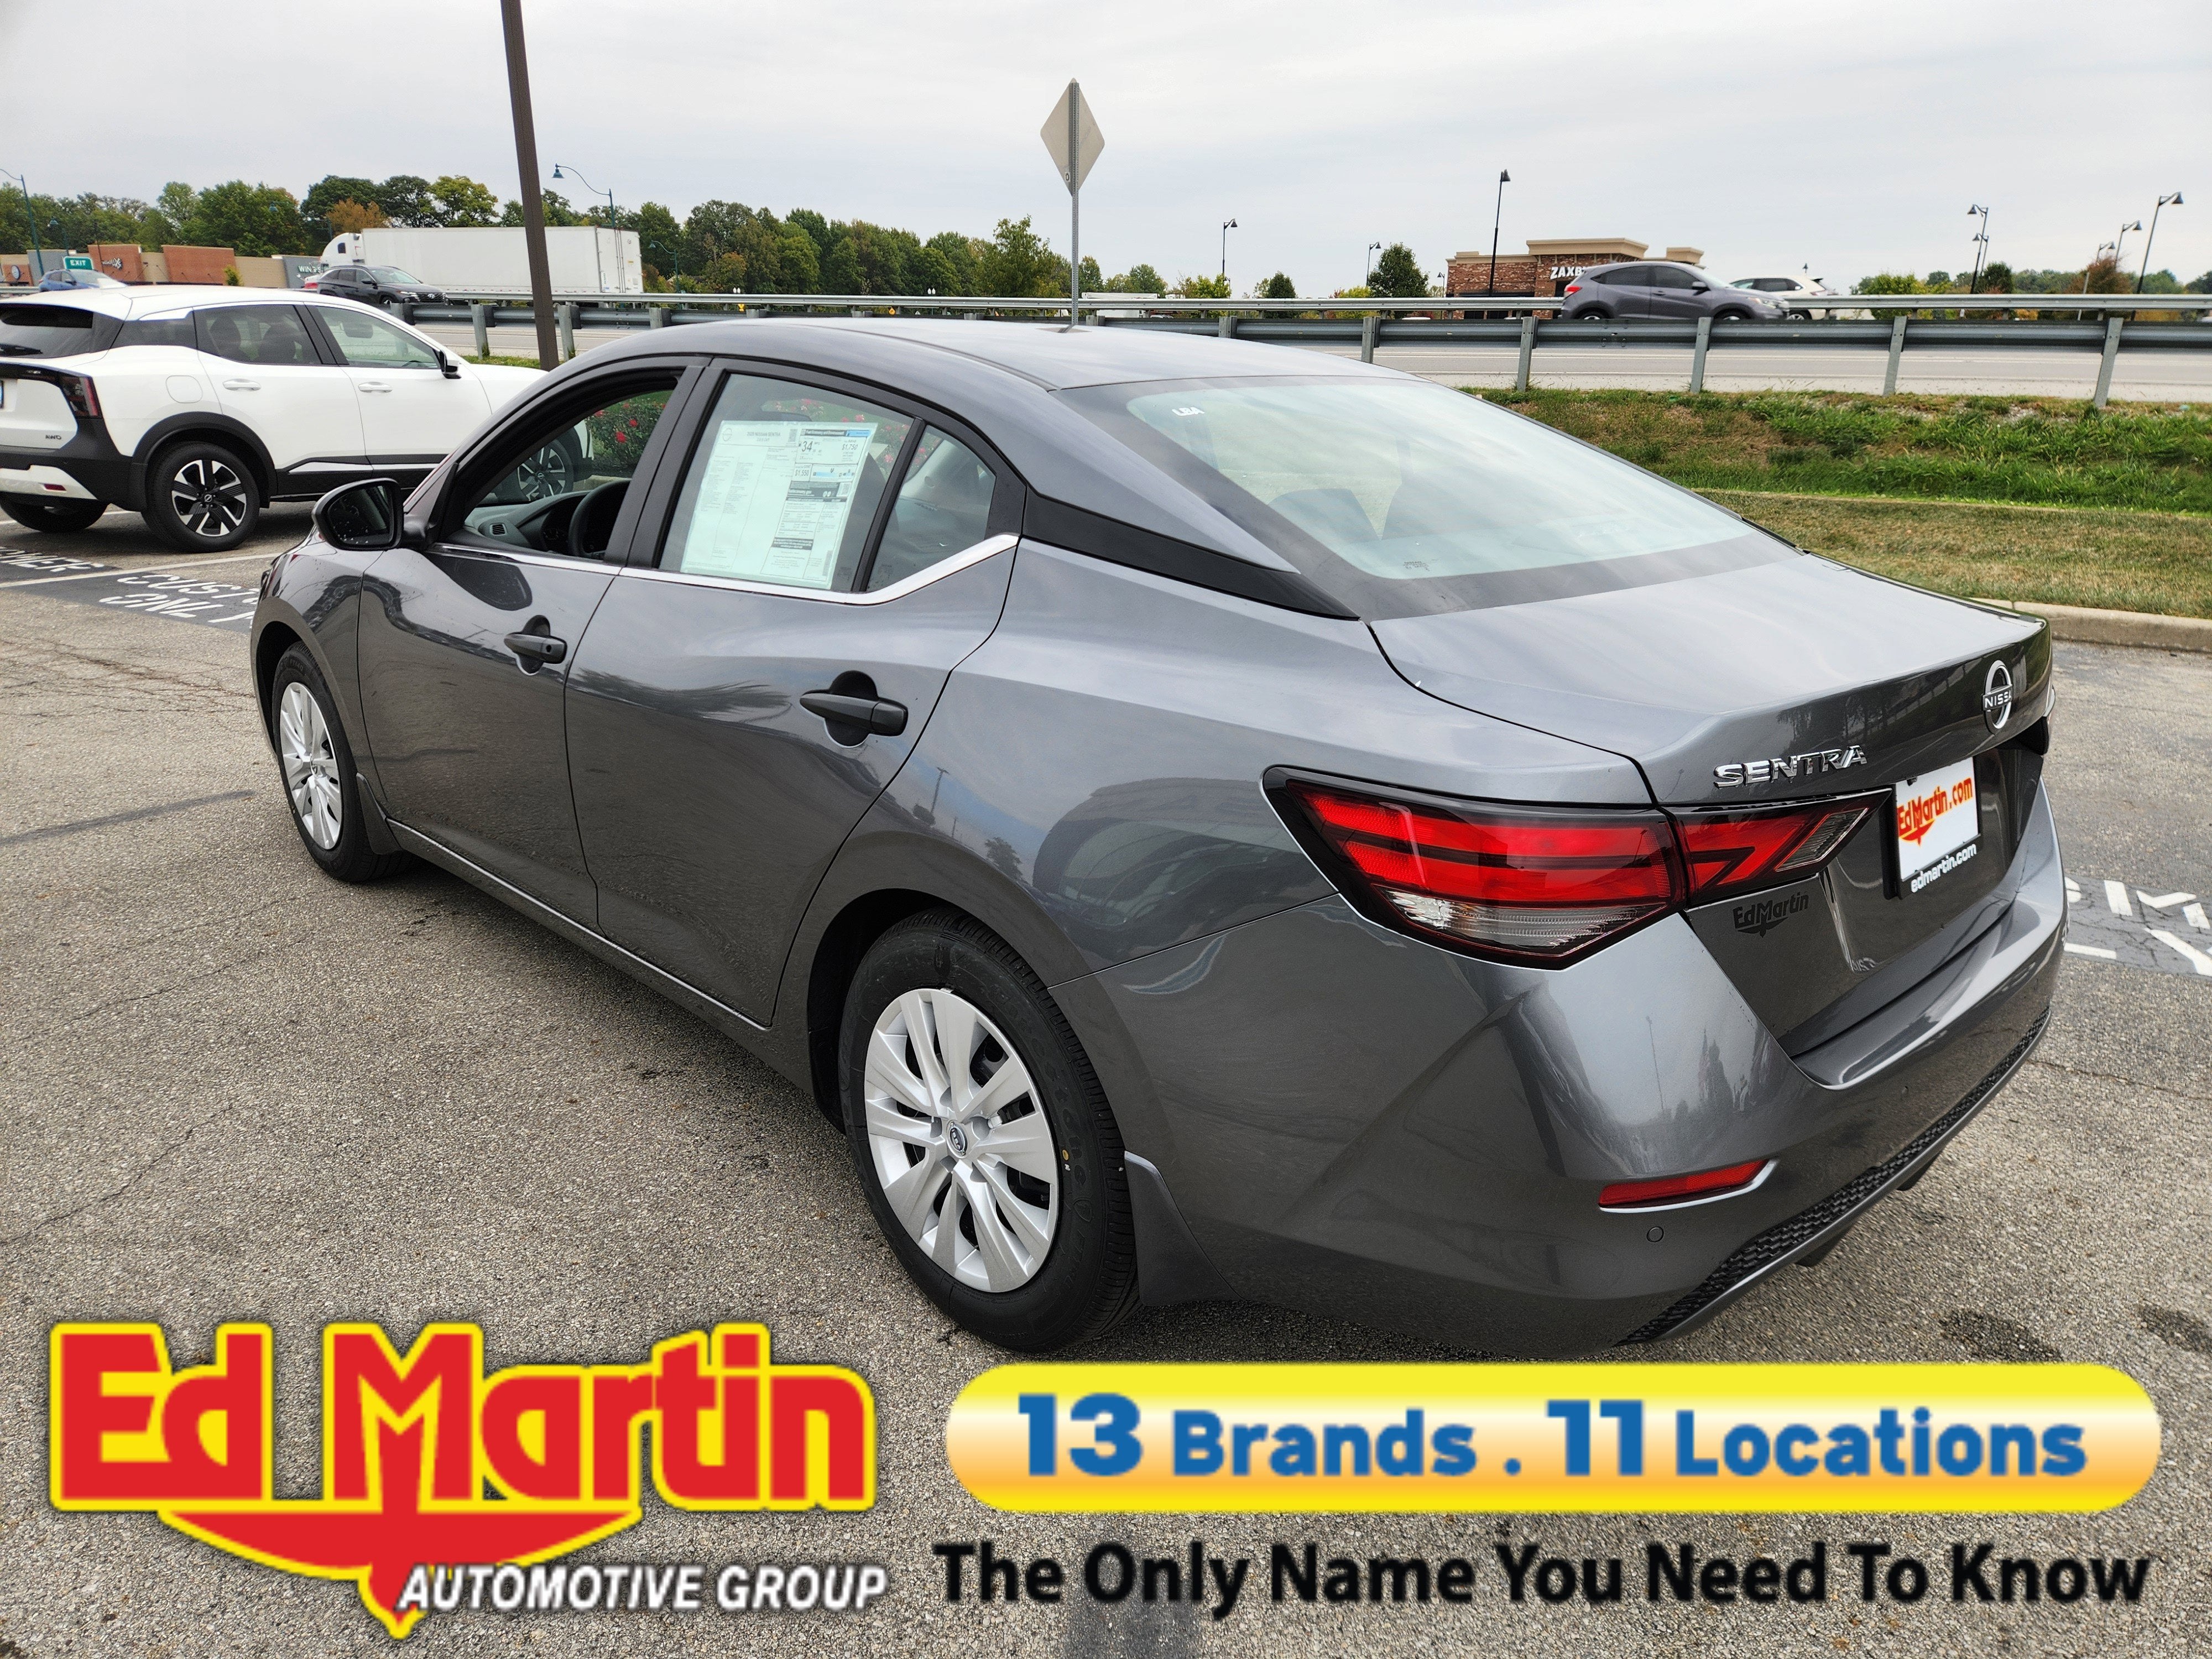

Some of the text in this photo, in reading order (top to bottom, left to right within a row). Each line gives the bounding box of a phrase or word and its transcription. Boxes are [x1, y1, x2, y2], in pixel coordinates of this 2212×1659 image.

[1550, 266, 1586, 280] ZAXB
[802, 441, 813, 452] 34
[1984, 690, 2011, 708] NISS
[1713, 745, 1867, 789] SENTRA
[1911, 843, 1977, 893] edmartin.com
[1733, 891, 1809, 930] EdMartin
